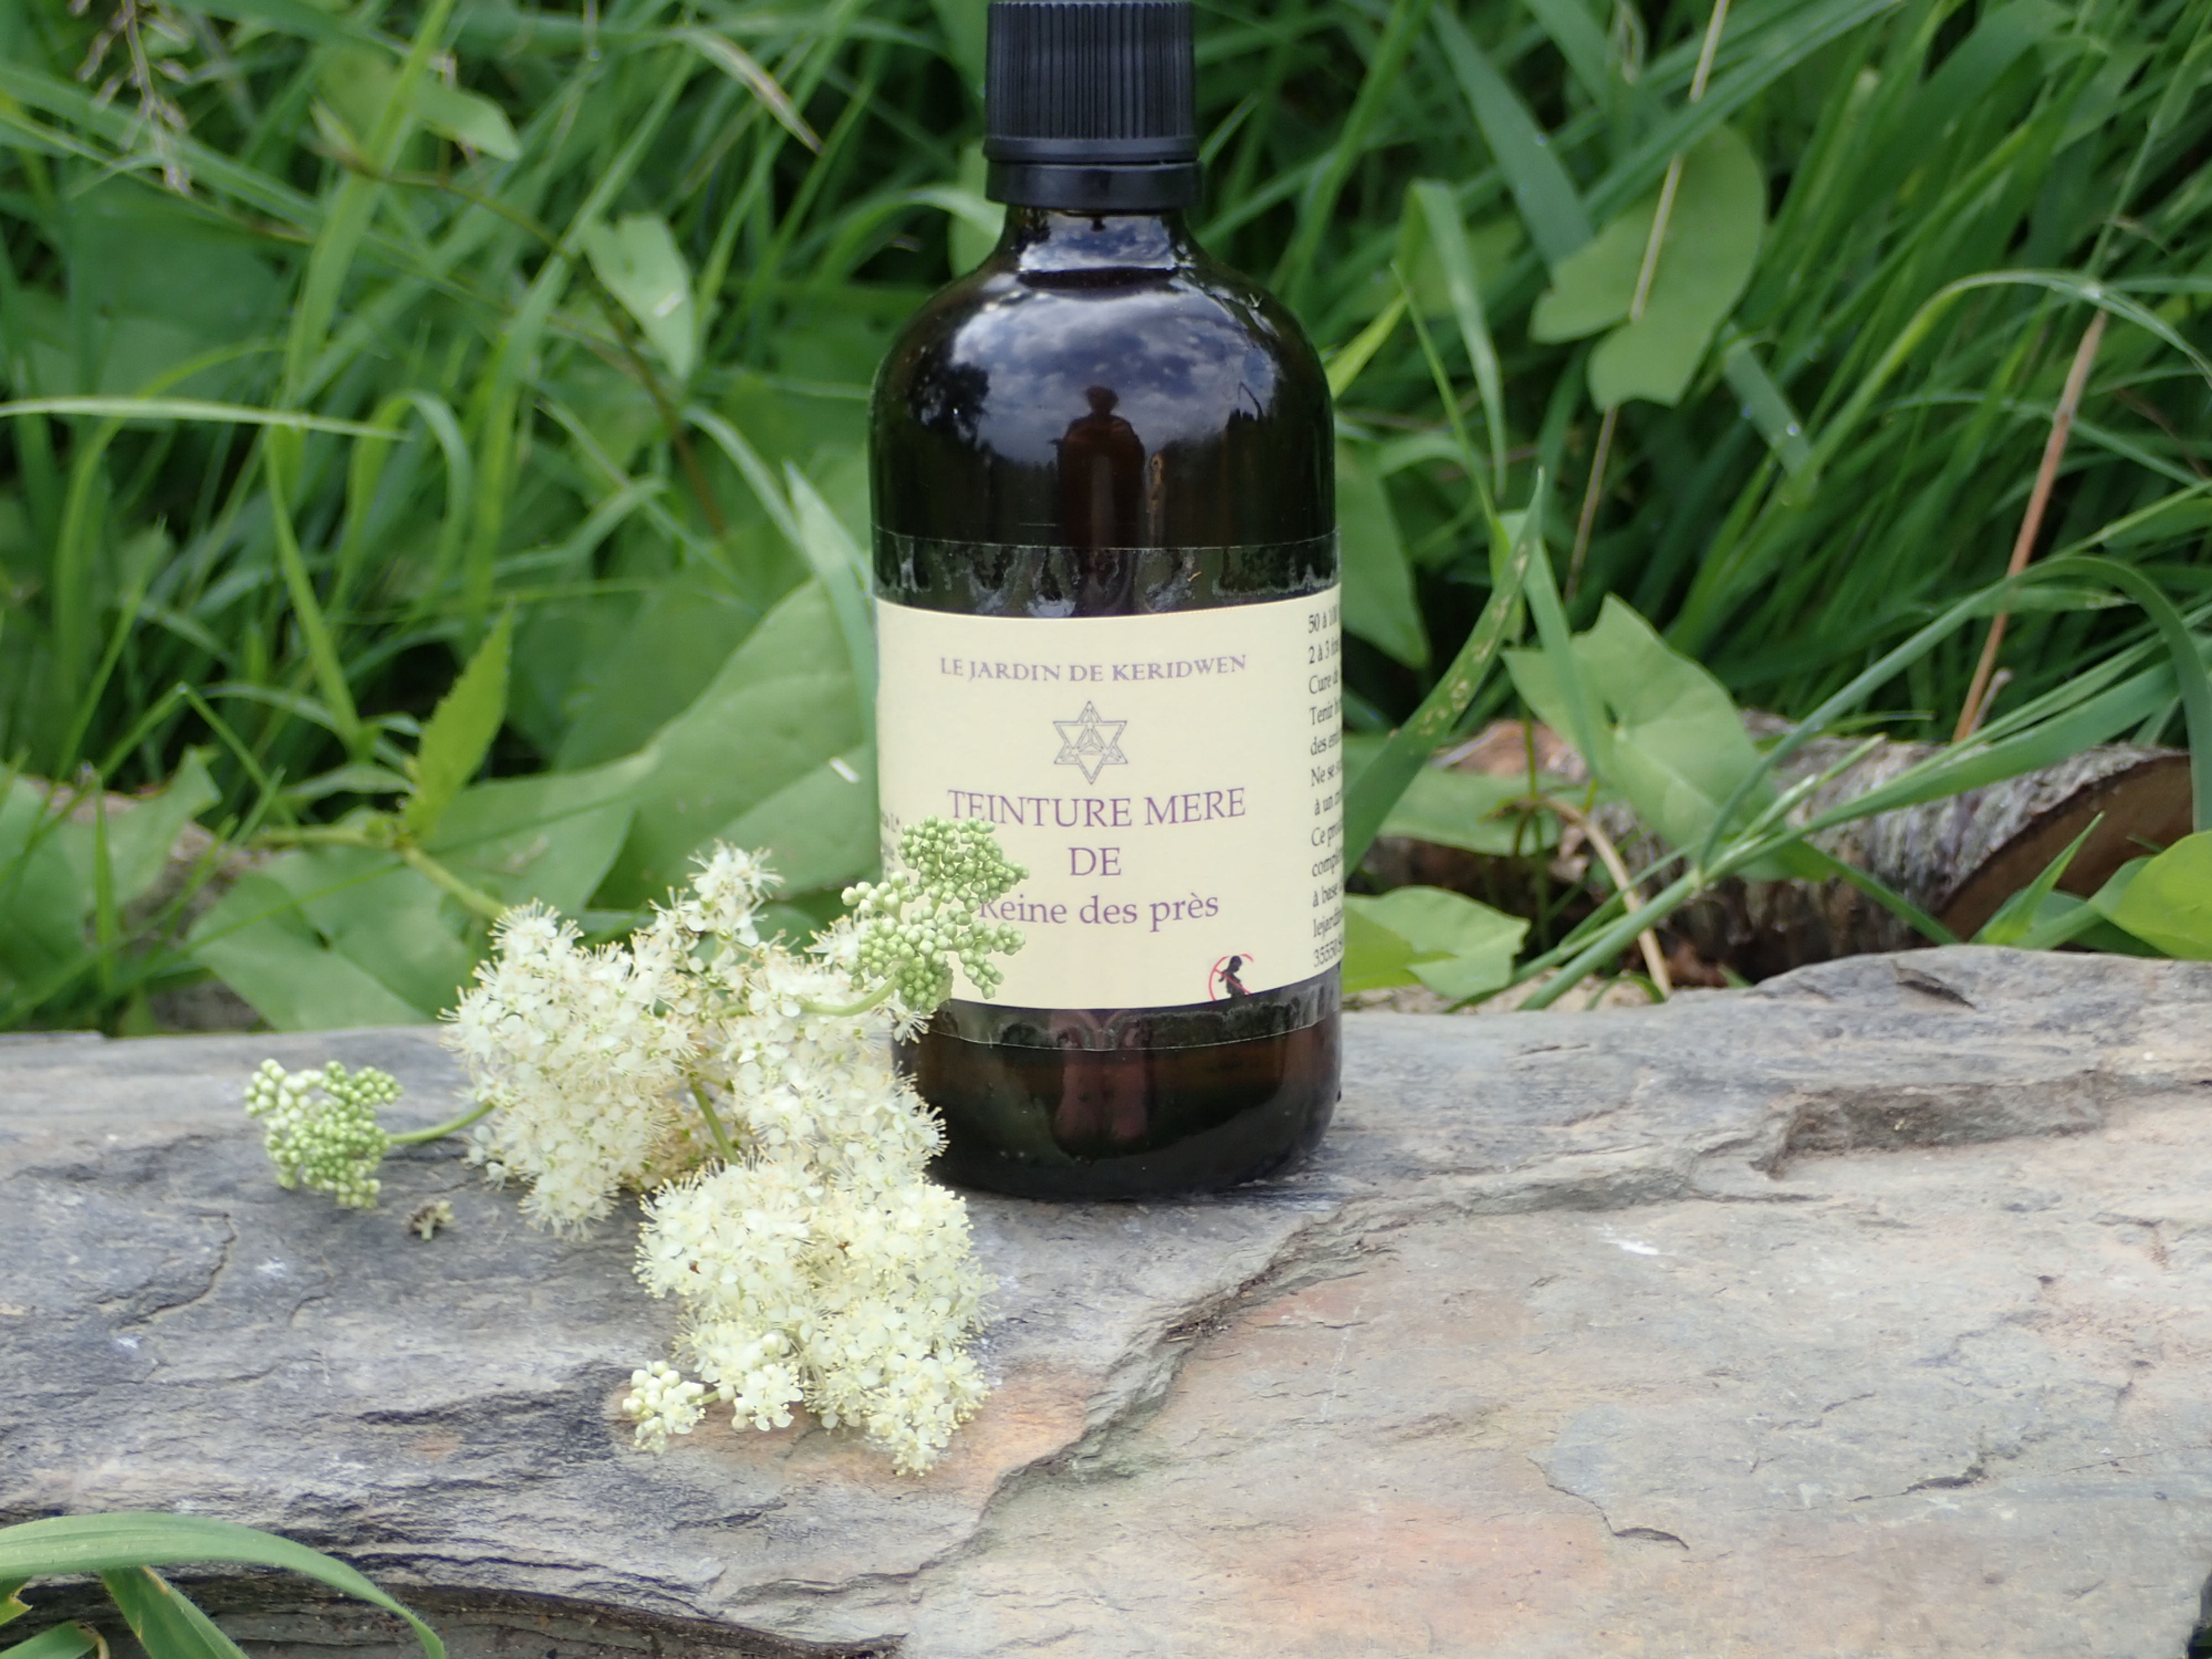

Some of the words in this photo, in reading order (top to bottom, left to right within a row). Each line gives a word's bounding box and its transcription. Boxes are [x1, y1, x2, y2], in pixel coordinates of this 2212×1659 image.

[1308, 613, 1320, 633] 50
[1308, 646, 1315, 664] 2
[1324, 640, 1330, 659] 3
[940, 657, 964, 676] LE
[968, 661, 1061, 681] JARDIN
[1069, 665, 1103, 682] DE
[1112, 654, 1246, 681] KERIDWEN
[1308, 674, 1331, 695] Cure
[1309, 701, 1333, 726] Tenir
[1310, 735, 1327, 755] des
[1311, 766, 1326, 787] Ne
[947, 789, 1133, 827] TEINTURE
[1144, 787, 1246, 826] MERE
[1314, 799, 1321, 816] à
[1311, 827, 1326, 847] Ce
[1068, 847, 1121, 877] DE
[978, 894, 1067, 924] Reine
[1079, 894, 1138, 925] des
[1149, 892, 1219, 933] près
